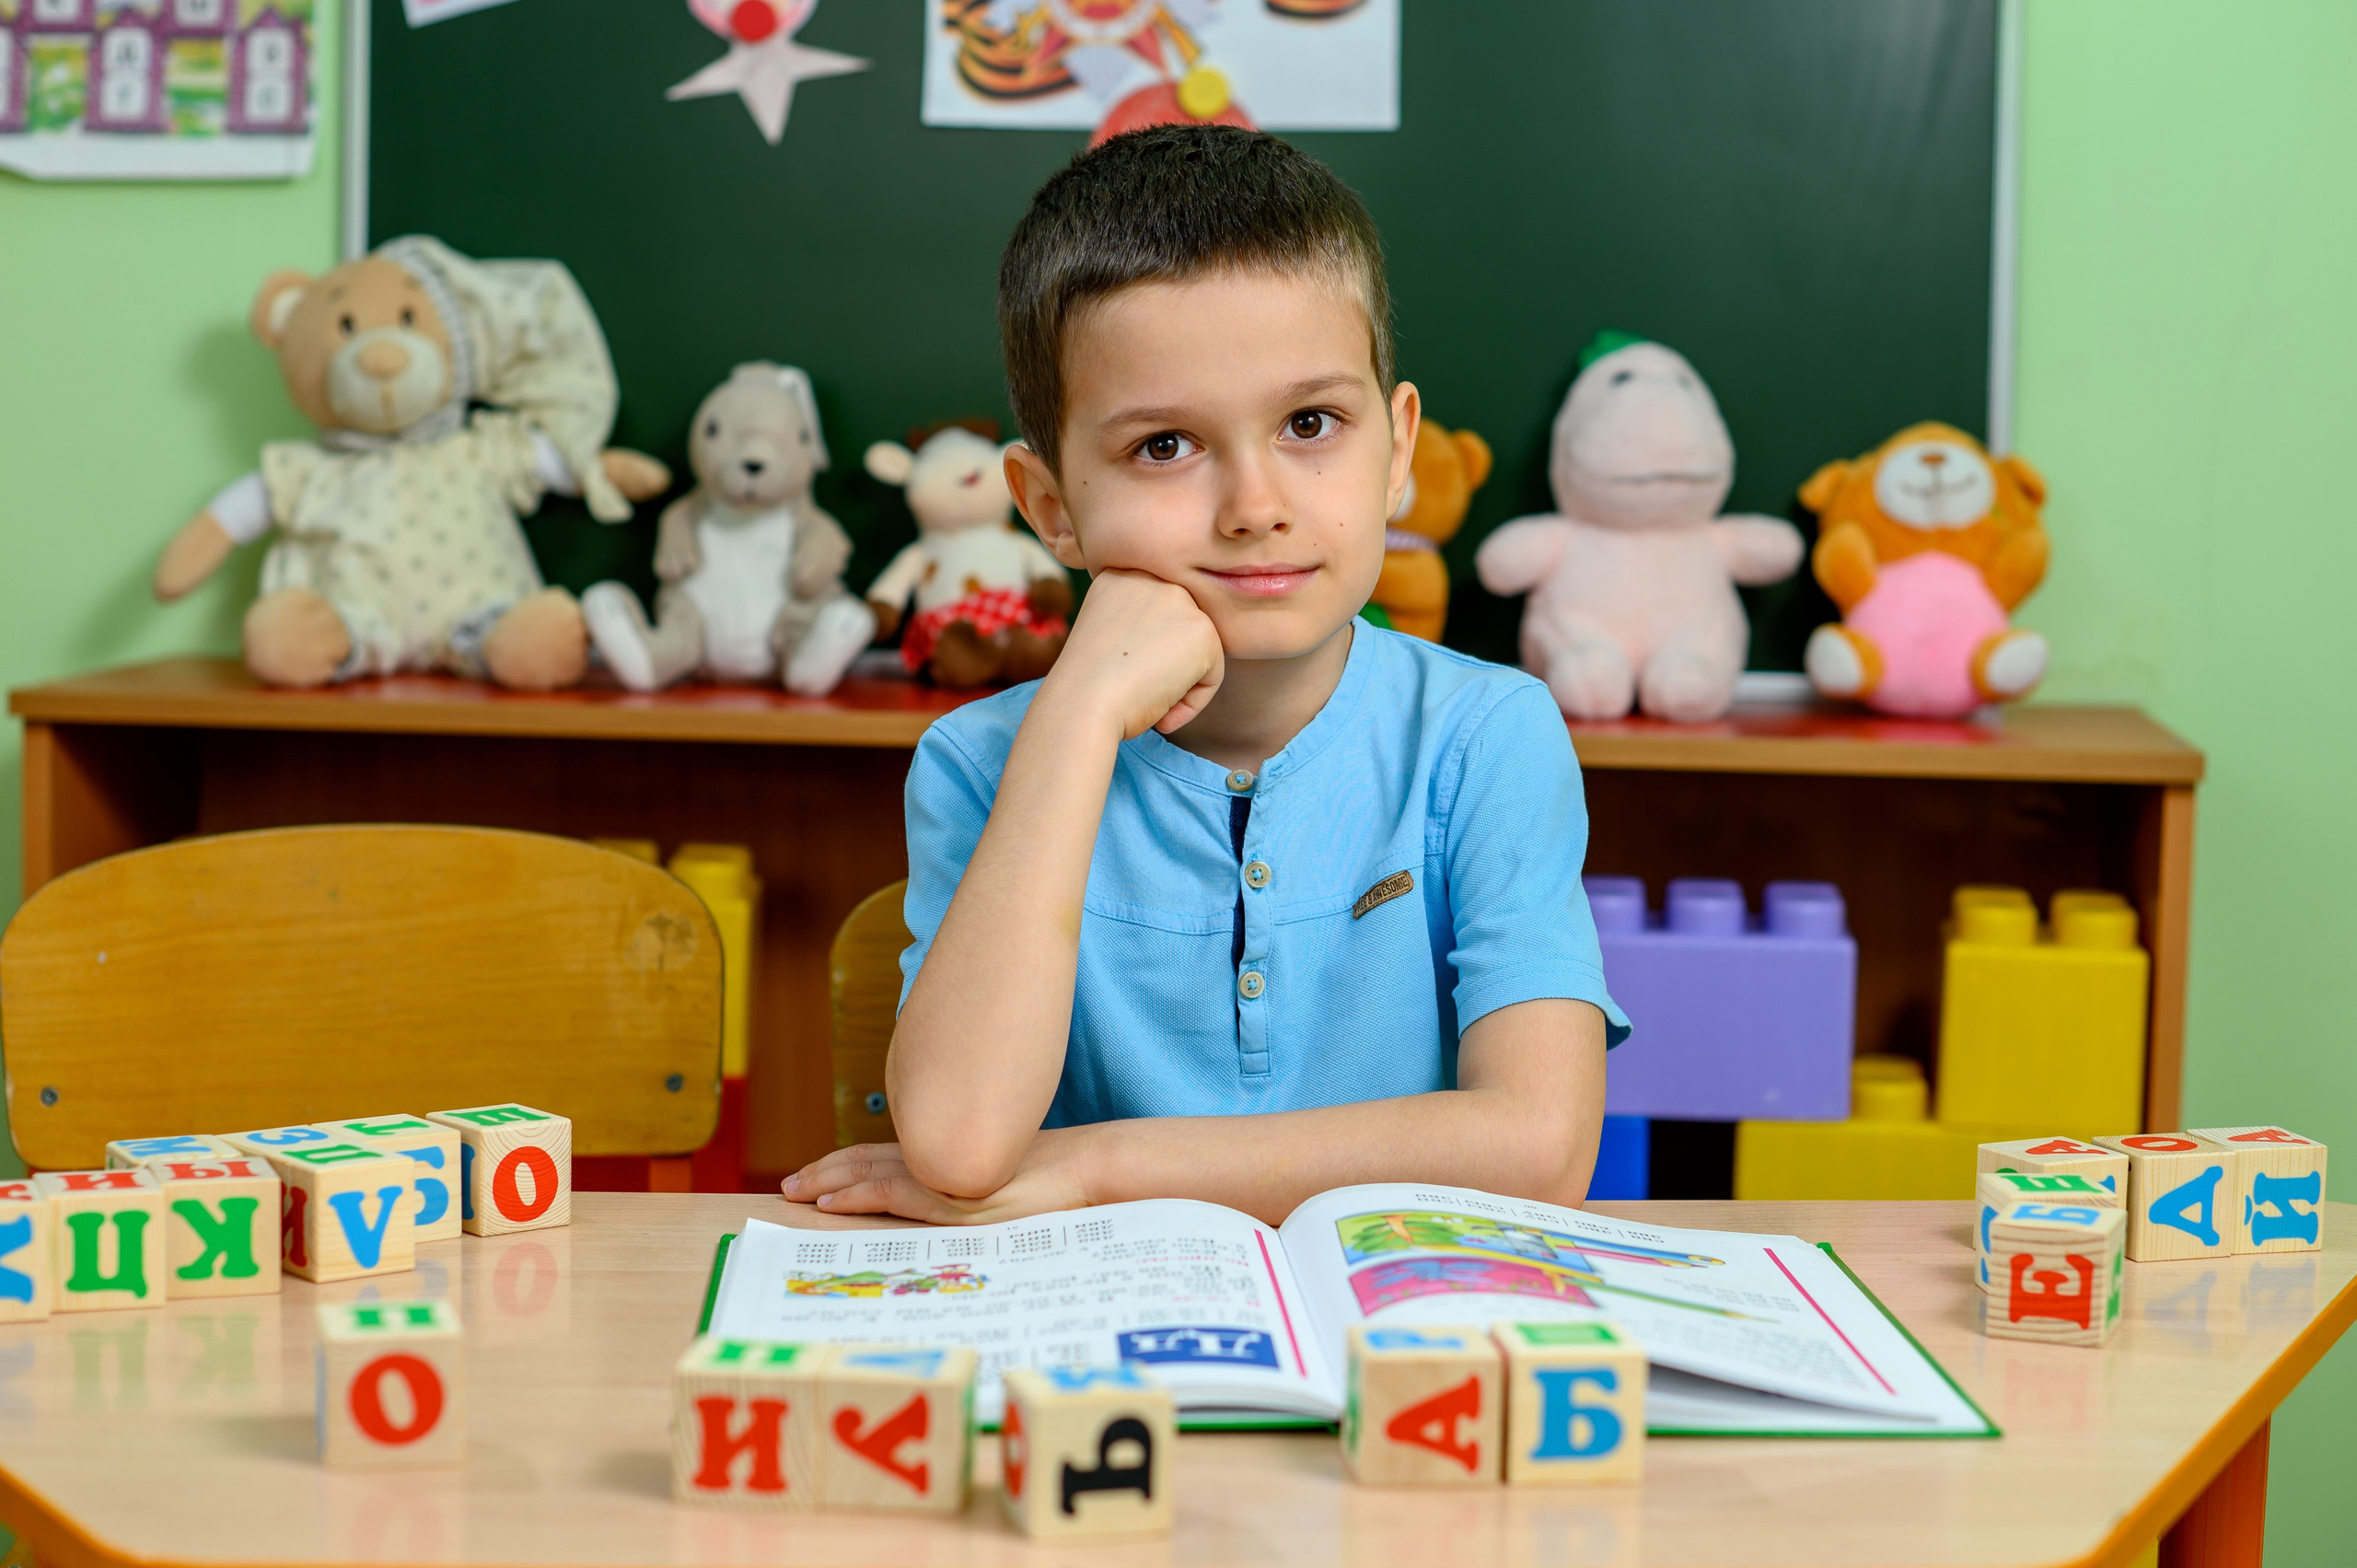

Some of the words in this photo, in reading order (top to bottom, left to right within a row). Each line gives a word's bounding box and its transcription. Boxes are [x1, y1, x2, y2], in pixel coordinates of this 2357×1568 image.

[163, 1161, 258, 1180] Ы
[2025, 1140, 2108, 1155] А
[2120, 1137, 2199, 1151] О
[2227, 1129, 2311, 1145] А
[57, 1172, 145, 1191] И
[493, 1145, 559, 1223] О
[2148, 1165, 2223, 1247] А
[2244, 1170, 2321, 1247] Й
[66, 1210, 150, 1299] Ц
[170, 1197, 260, 1280] К
[2008, 1253, 2096, 1330] Е
[347, 1352, 445, 1448] О
[1385, 1373, 1483, 1475] А
[1529, 1366, 1625, 1462] Б
[692, 1394, 790, 1494] И
[832, 1390, 930, 1497] У
